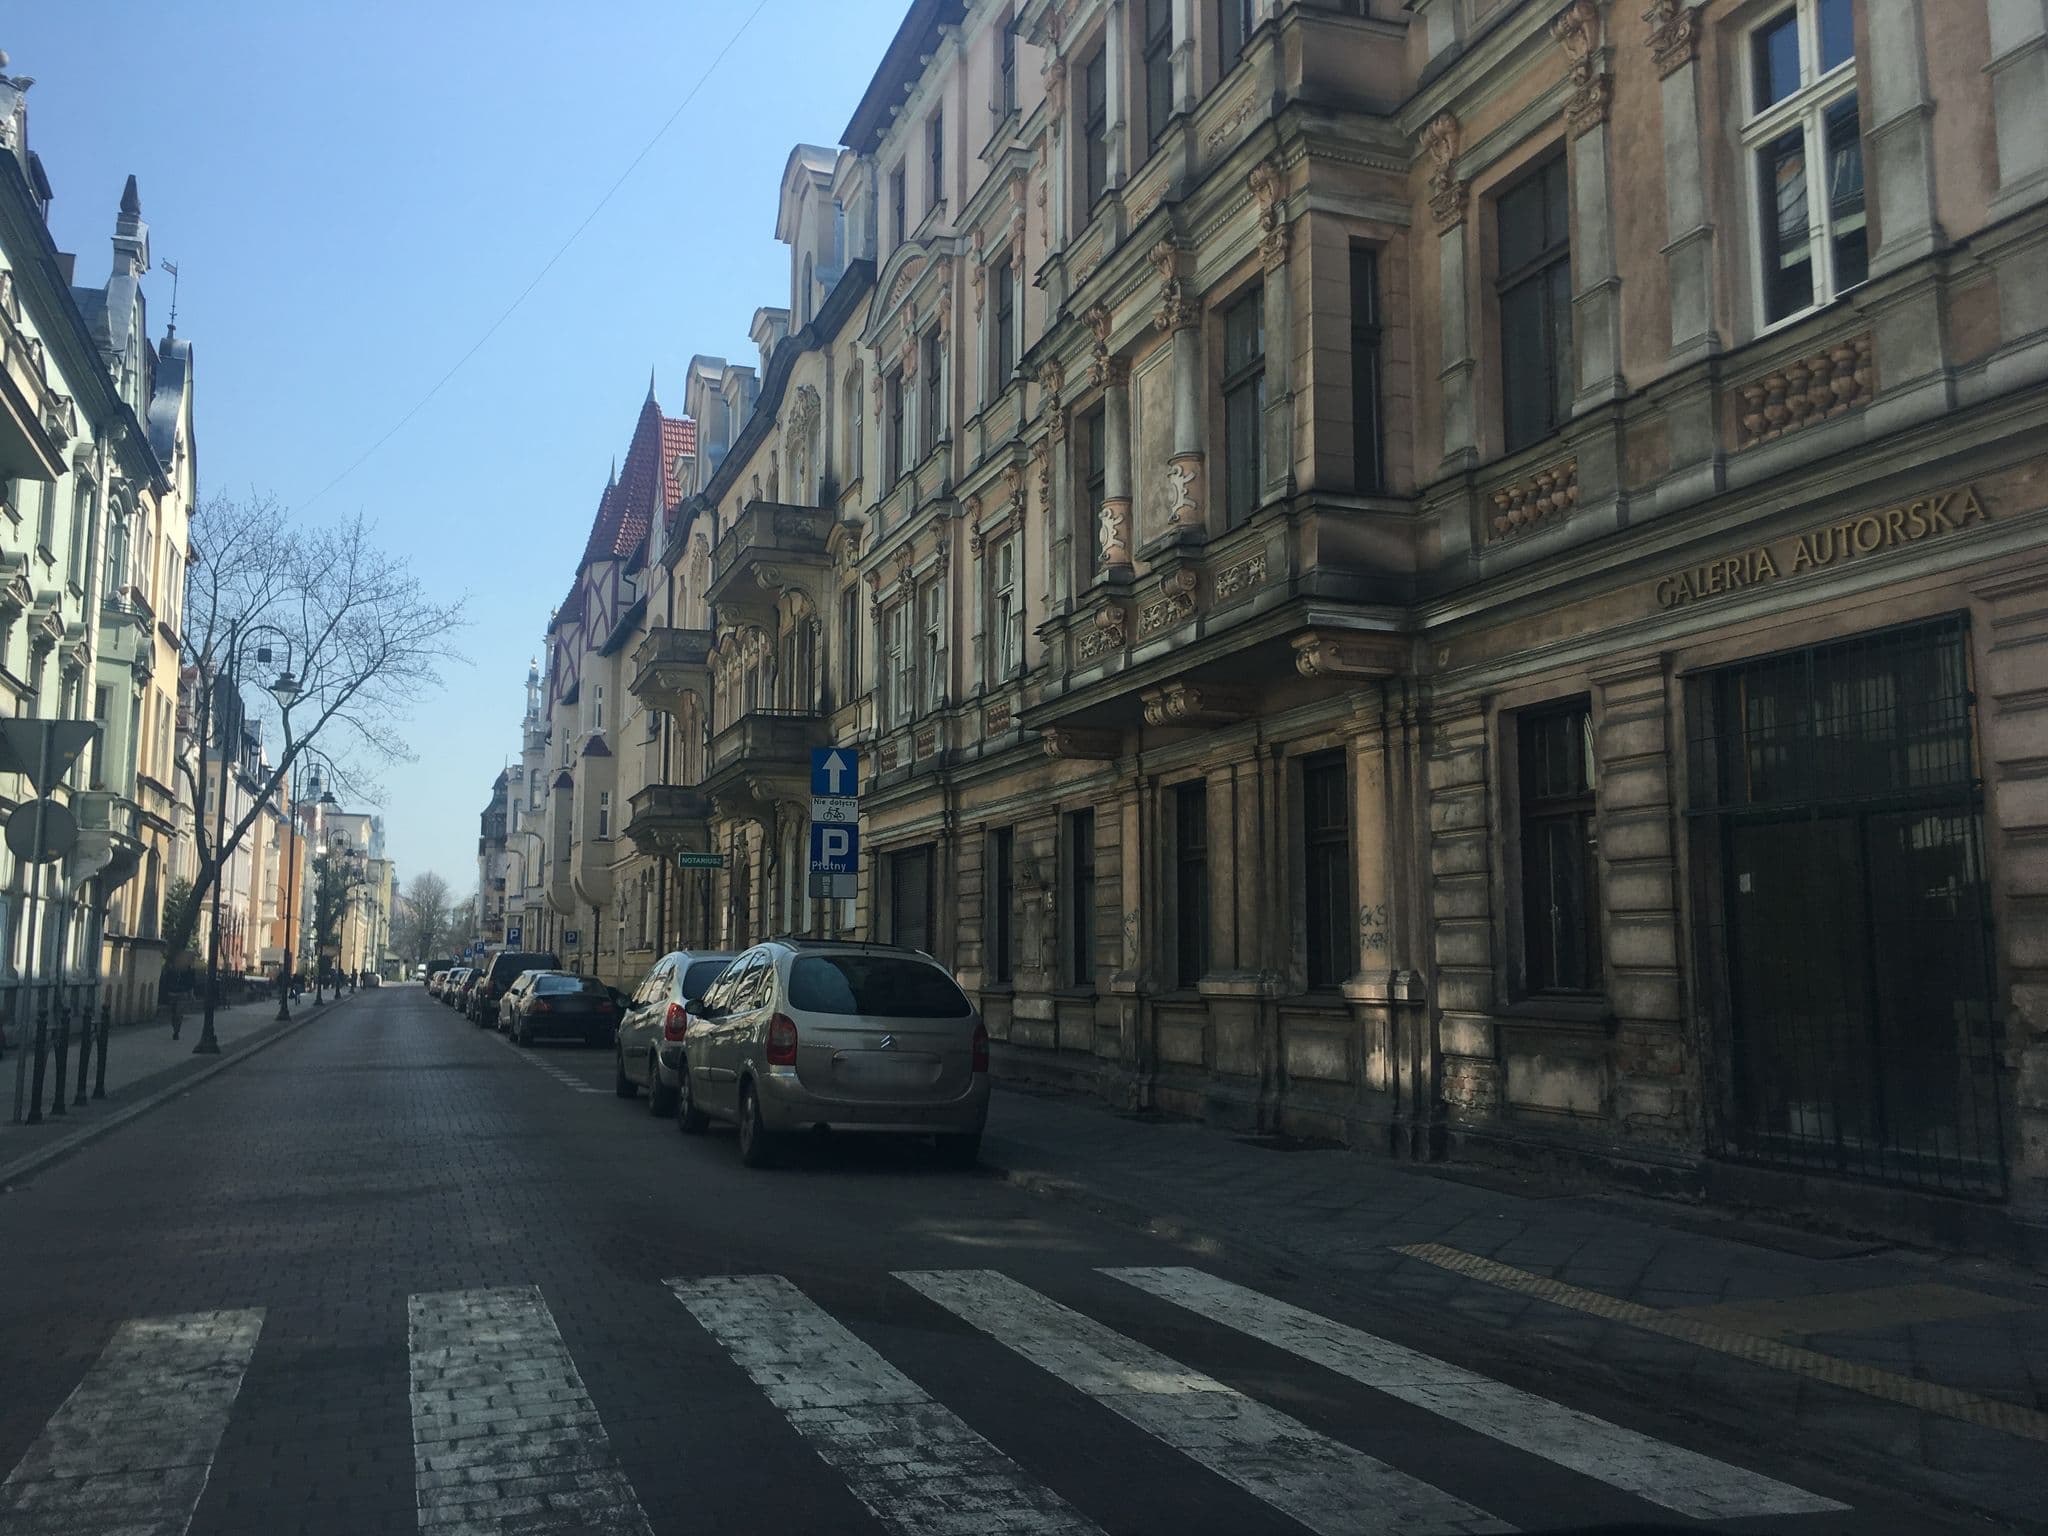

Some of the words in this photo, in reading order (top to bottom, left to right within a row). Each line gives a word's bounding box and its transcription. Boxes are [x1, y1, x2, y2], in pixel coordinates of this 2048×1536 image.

[1656, 547, 1778, 609] GALERIA
[1791, 486, 1986, 574] AUTORSKA
[829, 799, 857, 808] dotyczy
[822, 828, 849, 868] P
[682, 857, 721, 865] NOTARIUSZ
